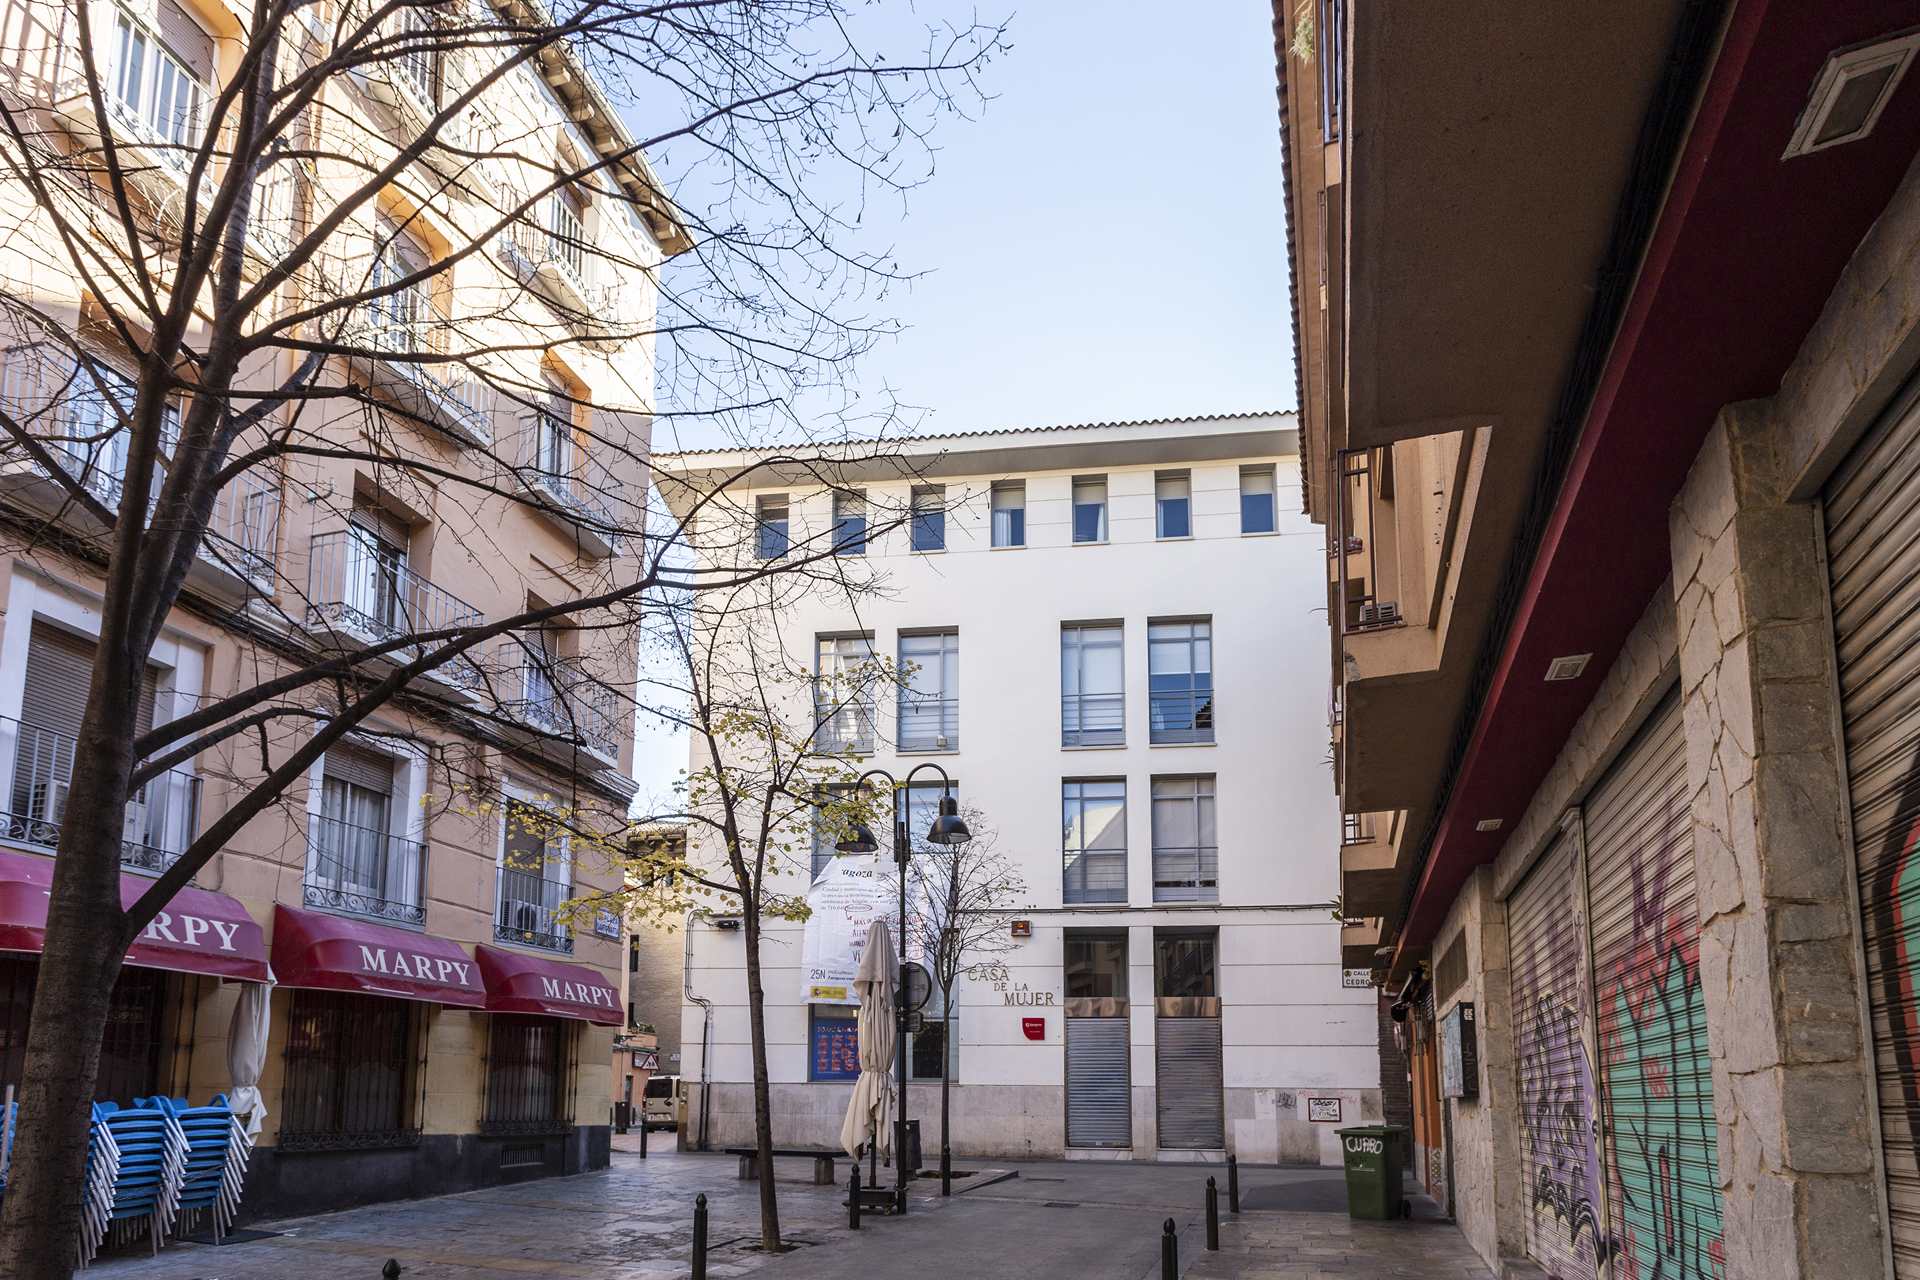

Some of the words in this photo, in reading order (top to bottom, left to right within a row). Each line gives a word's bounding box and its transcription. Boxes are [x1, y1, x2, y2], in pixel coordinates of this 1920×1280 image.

[359, 945, 470, 986] MARPY
[810, 968, 826, 980] 25N
[968, 968, 1010, 981] CASA
[541, 976, 612, 1007] MARPY
[994, 982, 1008, 991] DE
[1014, 982, 1028, 991] LA
[1004, 992, 1054, 1006] MUJER
[818, 1060, 854, 1071] DES
